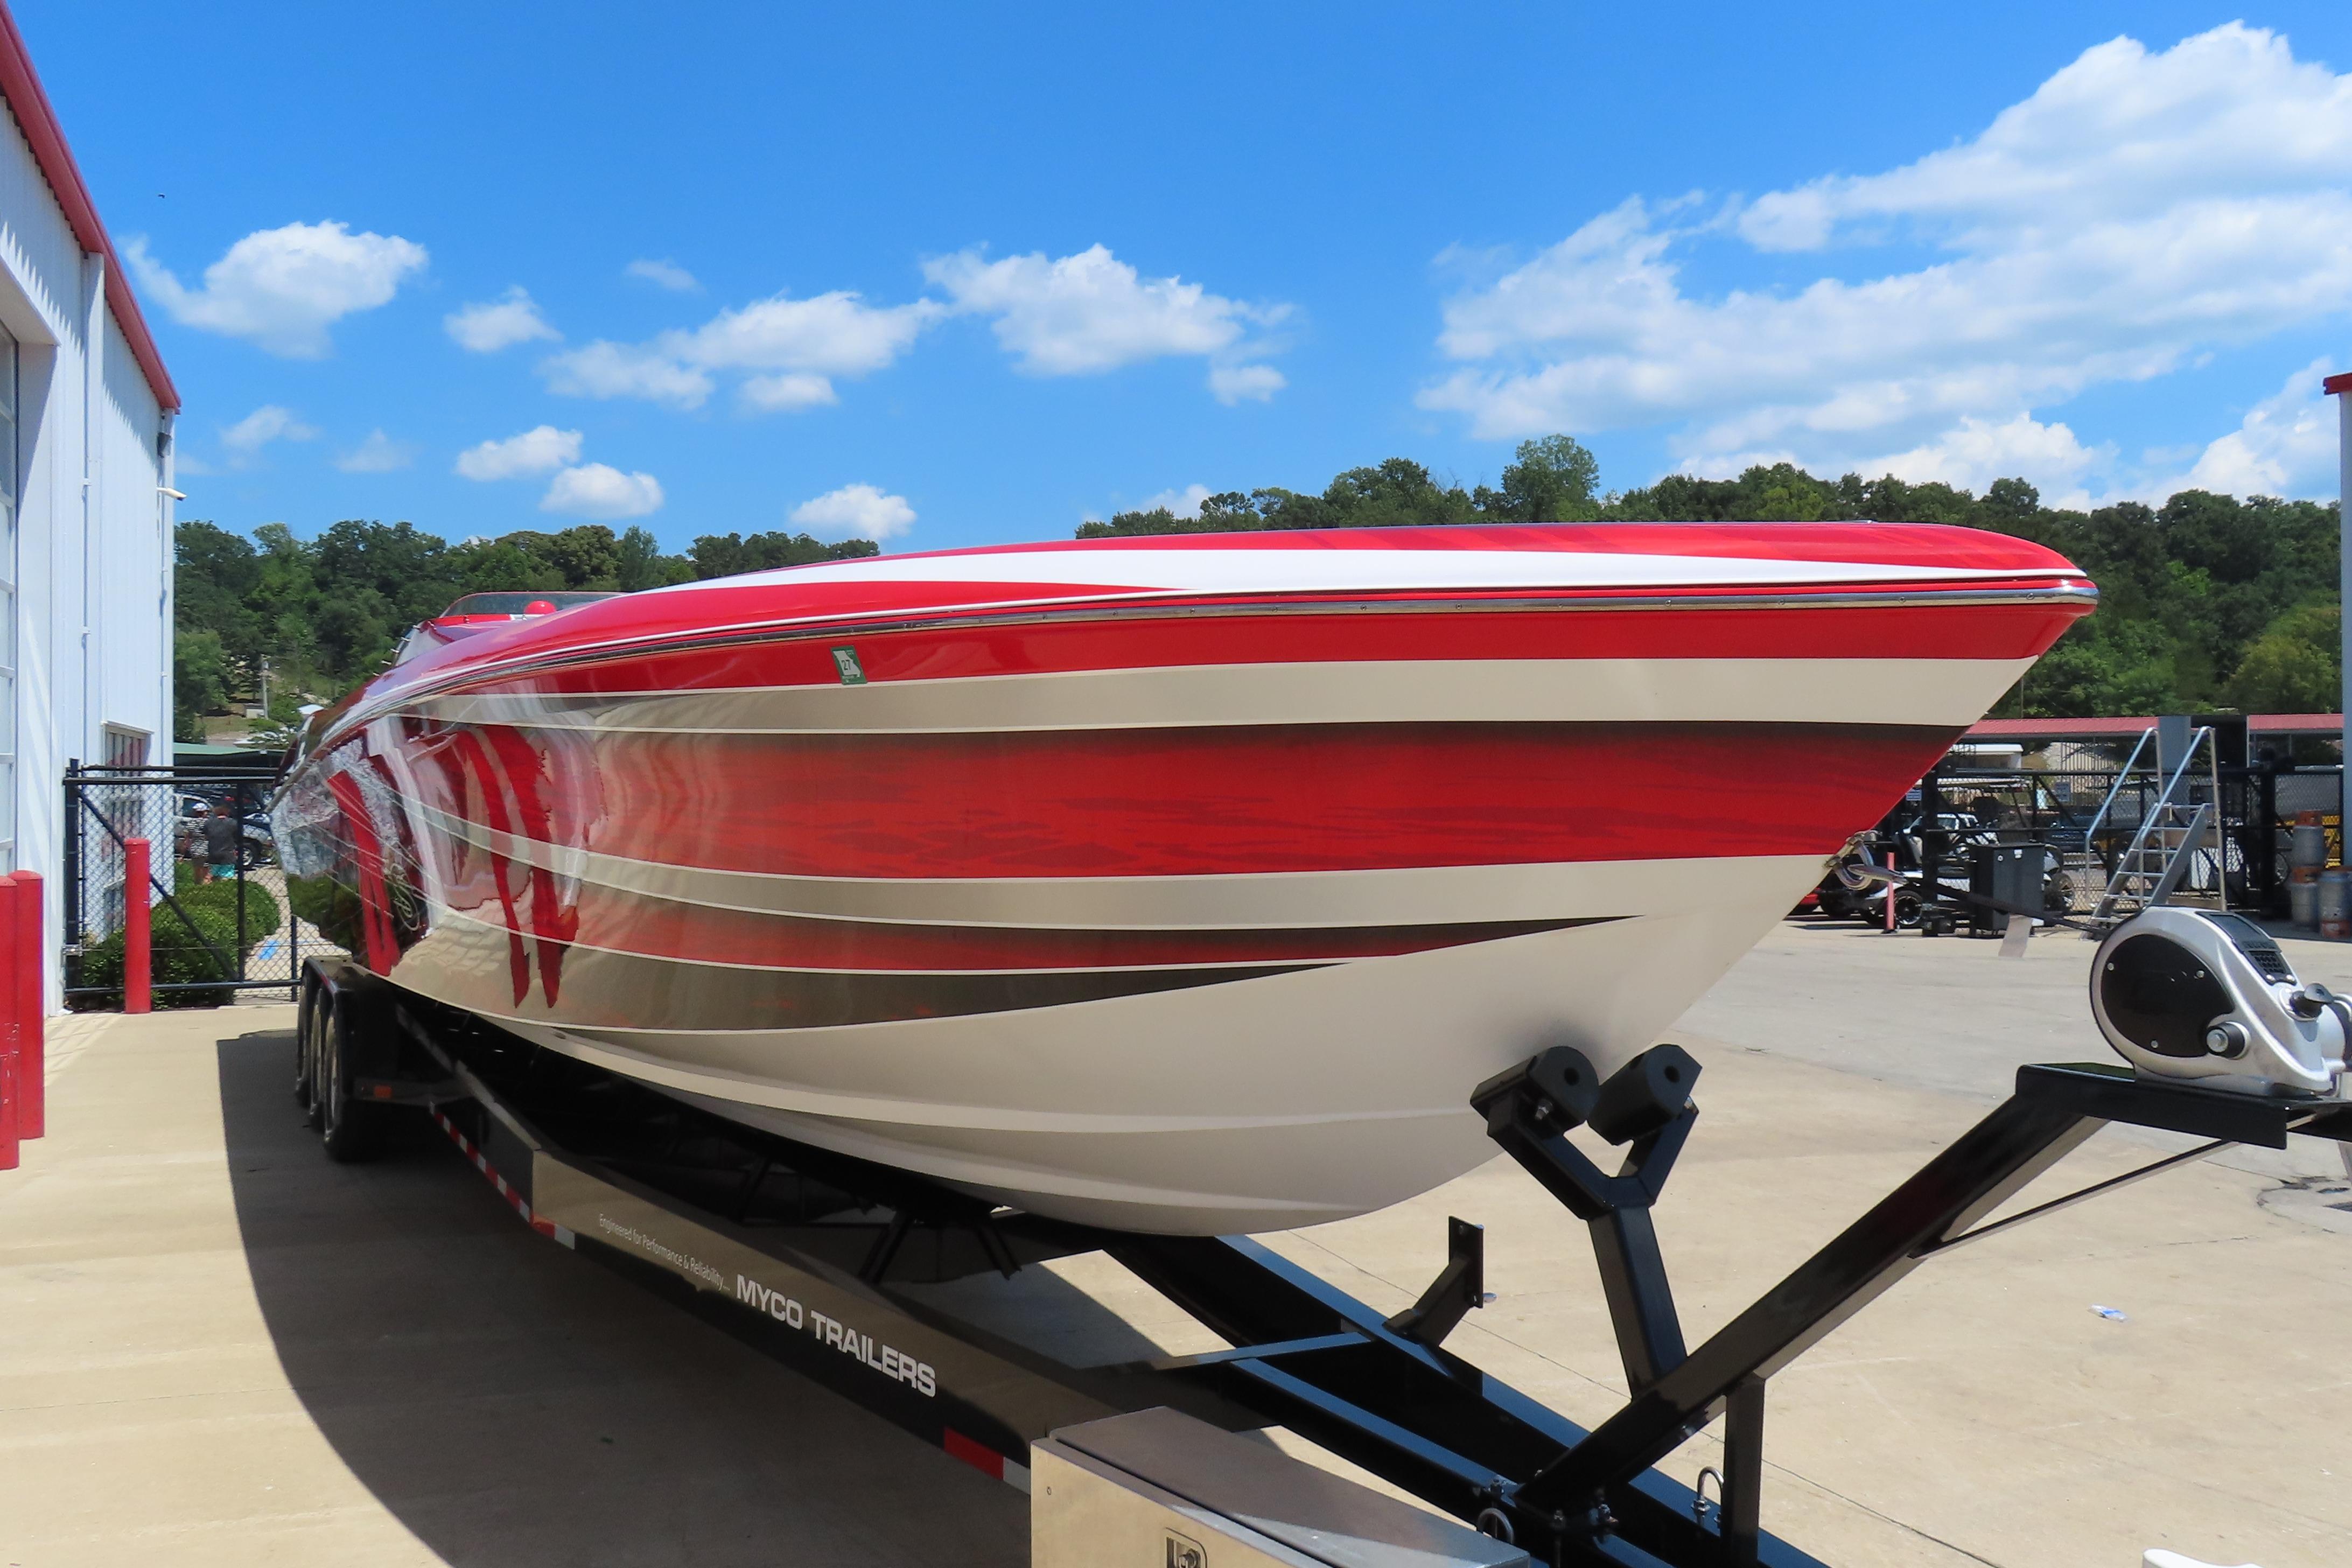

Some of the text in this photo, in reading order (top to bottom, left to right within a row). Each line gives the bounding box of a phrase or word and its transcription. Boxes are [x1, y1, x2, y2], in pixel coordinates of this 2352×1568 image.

[841, 660, 851, 670] 27
[599, 1213, 632, 1241] Engineered
[633, 1229, 642, 1245] for
[642, 1235, 683, 1266] Performance
[684, 1255, 689, 1269] &
[737, 1274, 936, 1397] MYCO TRAILERS
